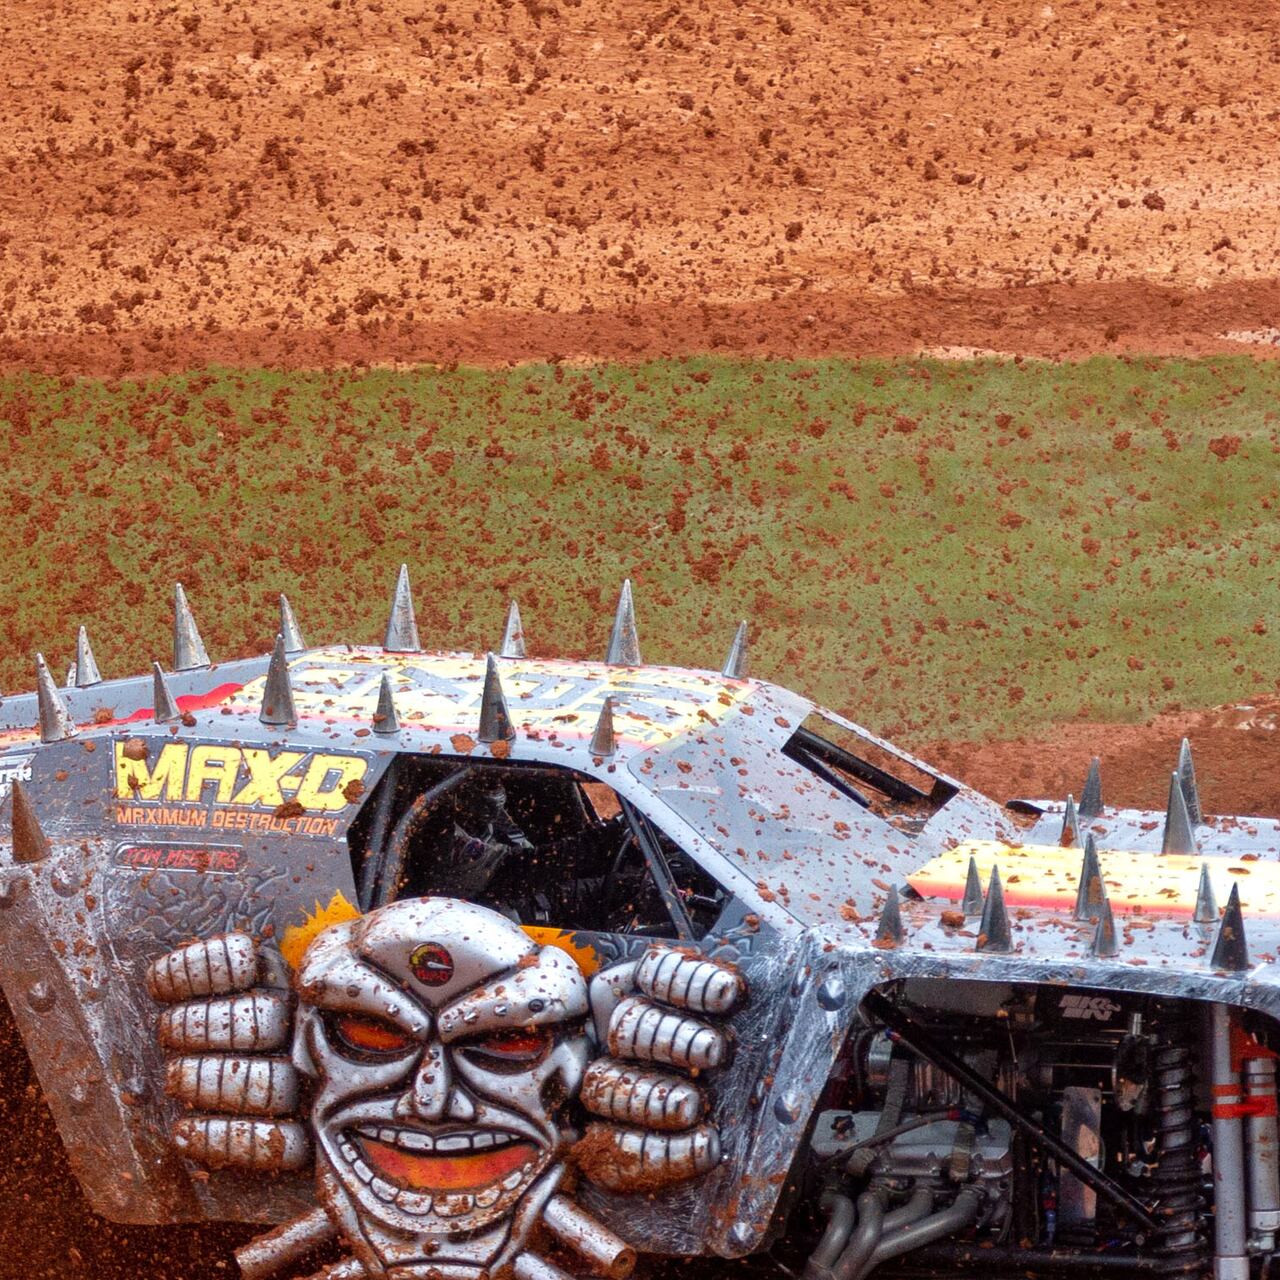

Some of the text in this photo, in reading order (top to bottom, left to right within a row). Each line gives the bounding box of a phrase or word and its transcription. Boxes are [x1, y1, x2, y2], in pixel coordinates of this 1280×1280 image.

[115, 741, 368, 812] MAX-D
[116, 807, 339, 835] MAXIMUM DESTRUCTION
